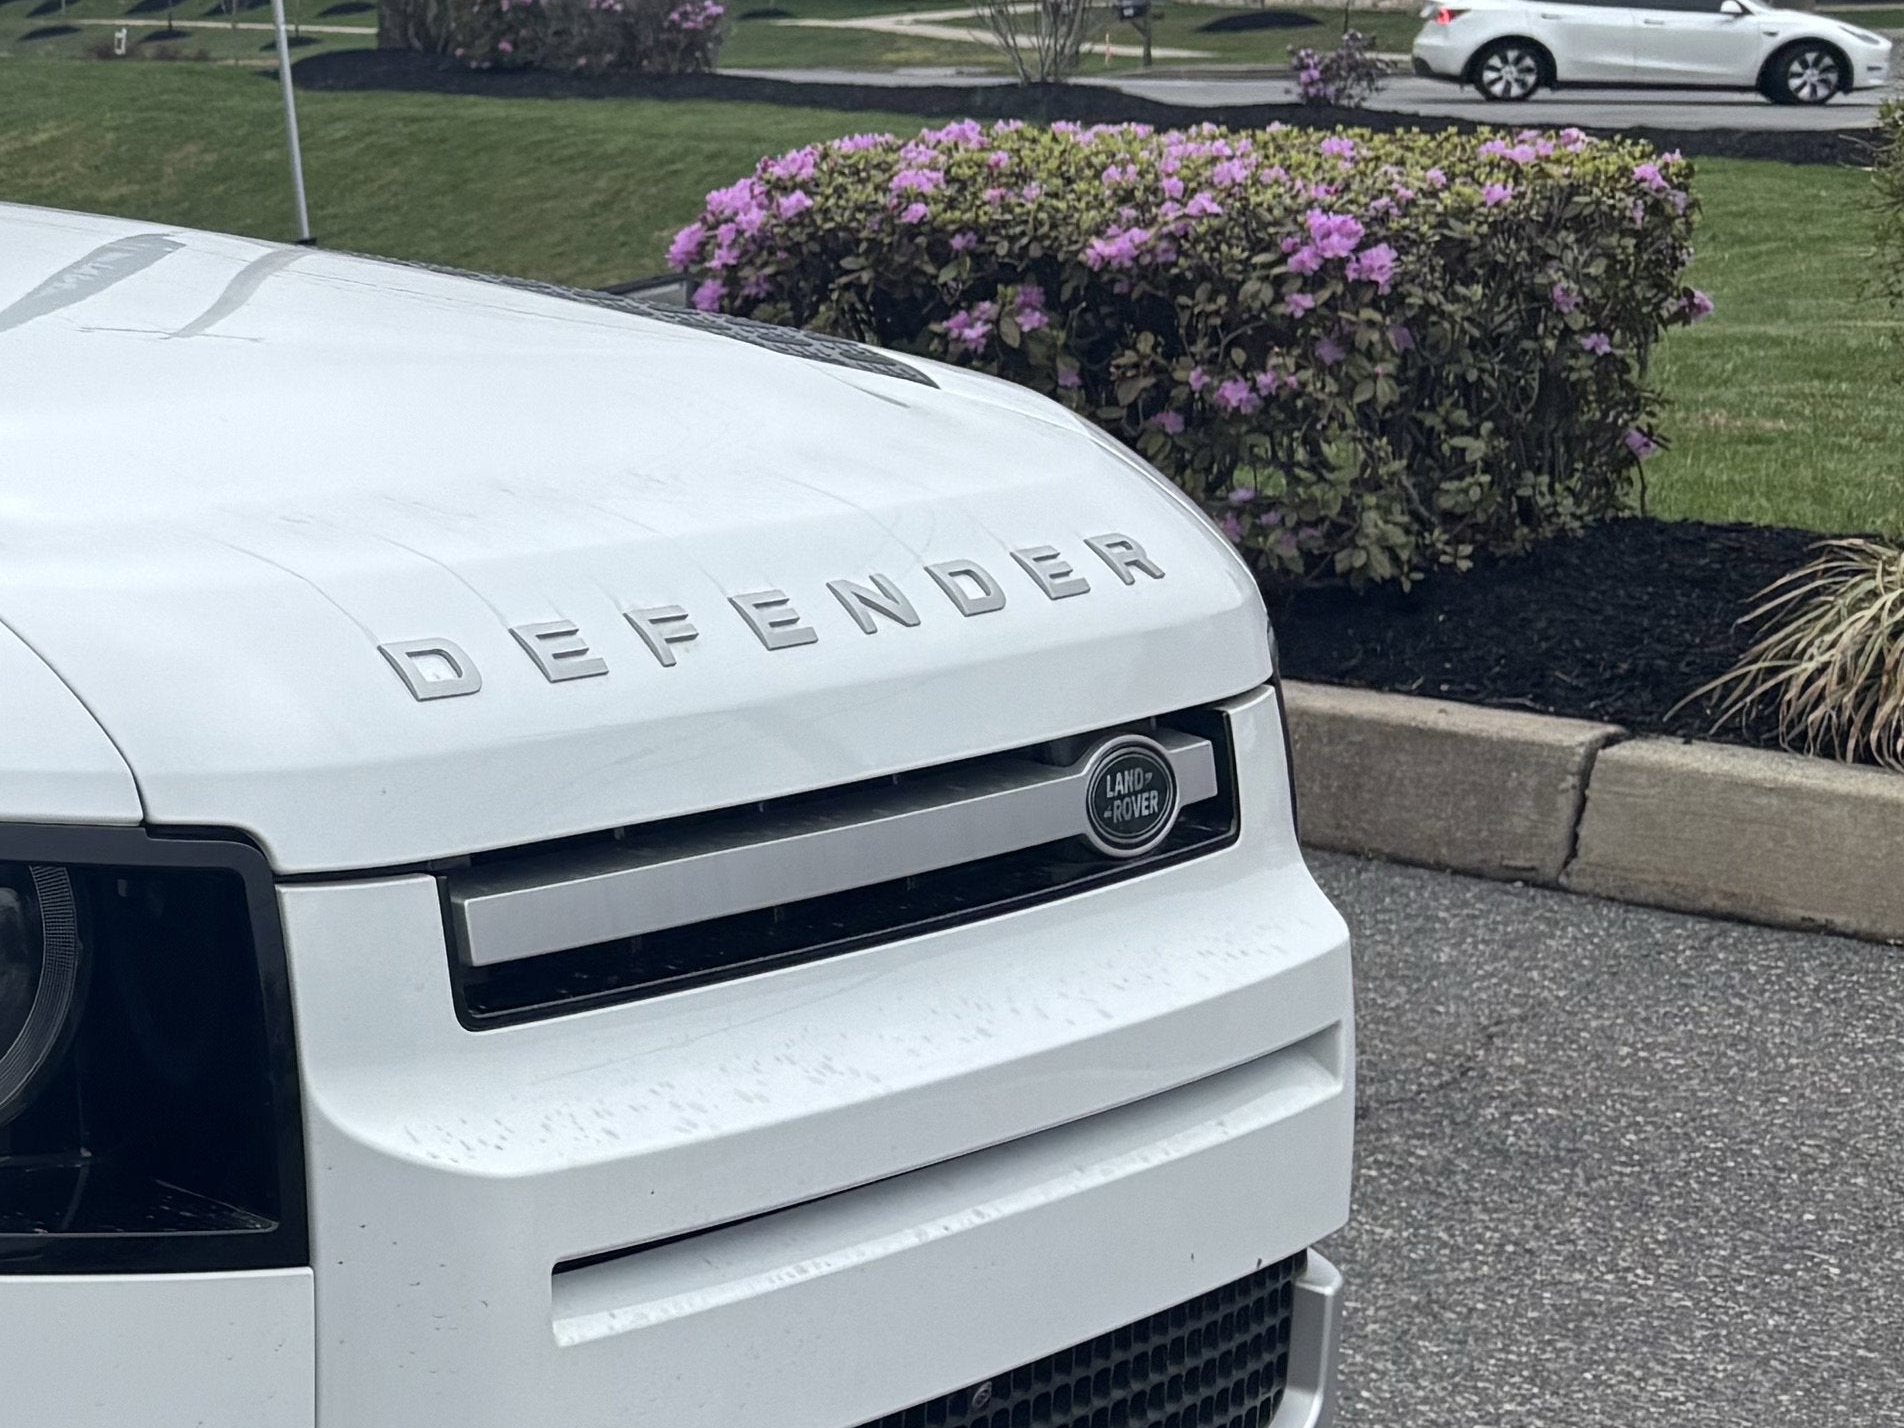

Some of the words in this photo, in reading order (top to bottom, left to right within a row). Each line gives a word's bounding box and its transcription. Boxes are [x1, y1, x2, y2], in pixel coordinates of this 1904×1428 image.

[377, 532, 1166, 702] DEFENDER
[1106, 767, 1144, 799] LAND
[1113, 790, 1159, 824] ROVER
